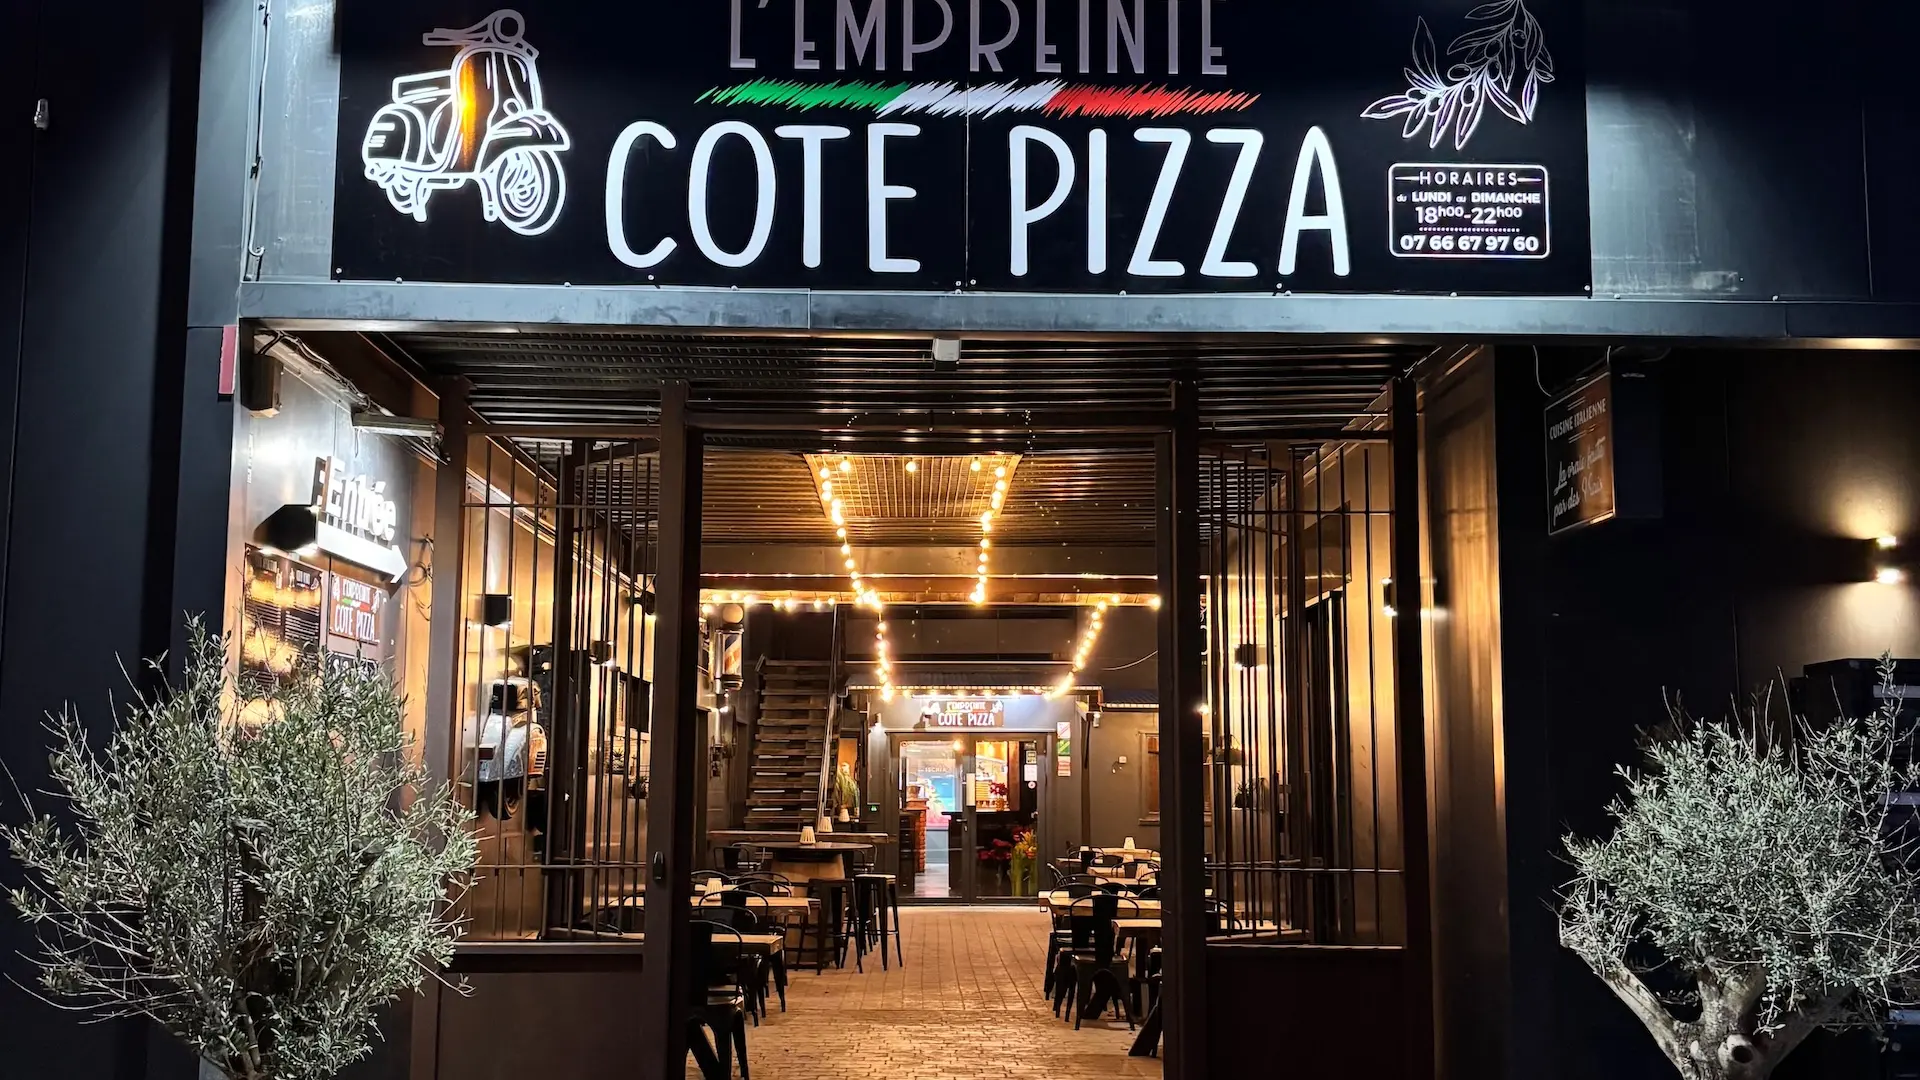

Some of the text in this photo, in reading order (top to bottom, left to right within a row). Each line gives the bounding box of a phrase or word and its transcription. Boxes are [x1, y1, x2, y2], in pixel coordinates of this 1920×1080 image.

[1419, 171, 1518, 186] HORAIRES
[604, 120, 1351, 278] COTE PIZZA
[1396, 194, 1407, 202] du
[1411, 191, 1452, 203] LUNDI
[1471, 192, 1541, 204] DIMANCHE
[1400, 235, 1539, 252] 07 66 67 97 60
[1549, 397, 1606, 440] CUISINE ITALIENNE
[326, 455, 397, 542] Entrée
[335, 603, 354, 637] COTE
[356, 609, 375, 642] PIZZA
[938, 712, 995, 726] COTE PIZZA
